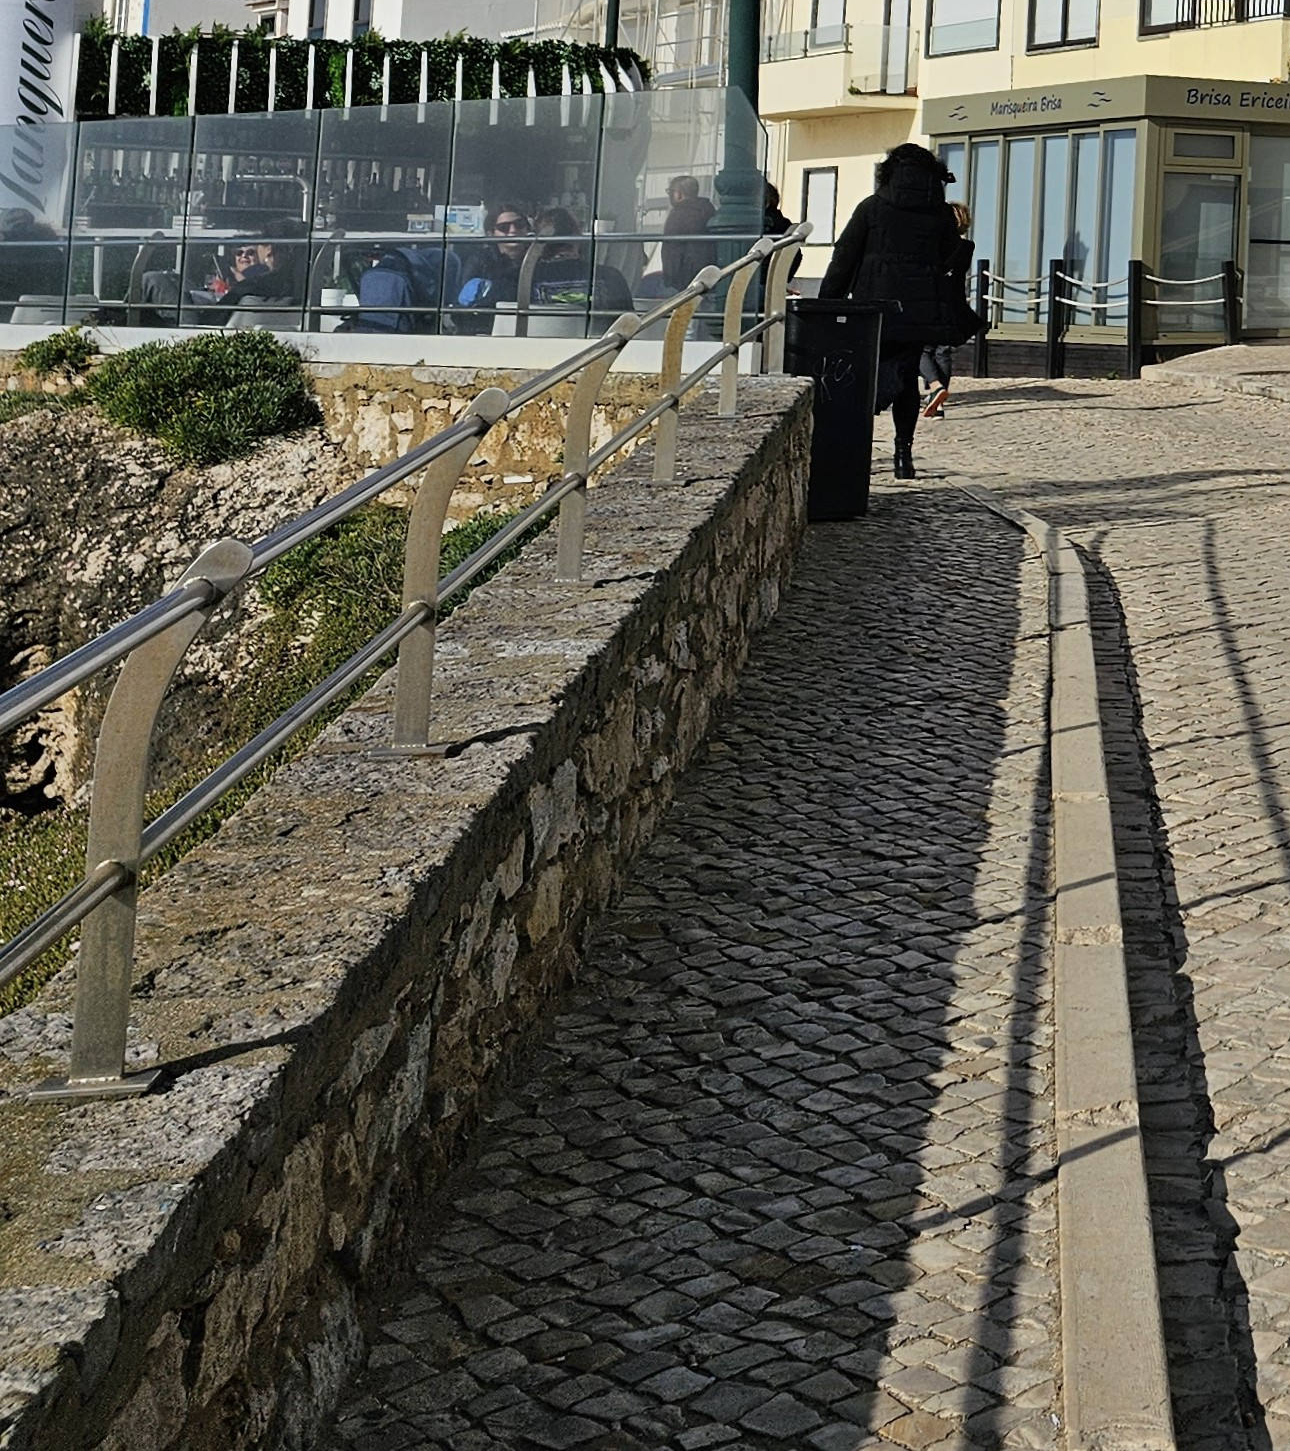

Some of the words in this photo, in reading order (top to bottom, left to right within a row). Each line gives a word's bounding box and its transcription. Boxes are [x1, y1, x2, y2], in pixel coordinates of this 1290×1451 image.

[990, 96, 1038, 120] Marisqueira
[1040, 93, 1063, 113] Brisa
[1186, 88, 1232, 107] Brisa
